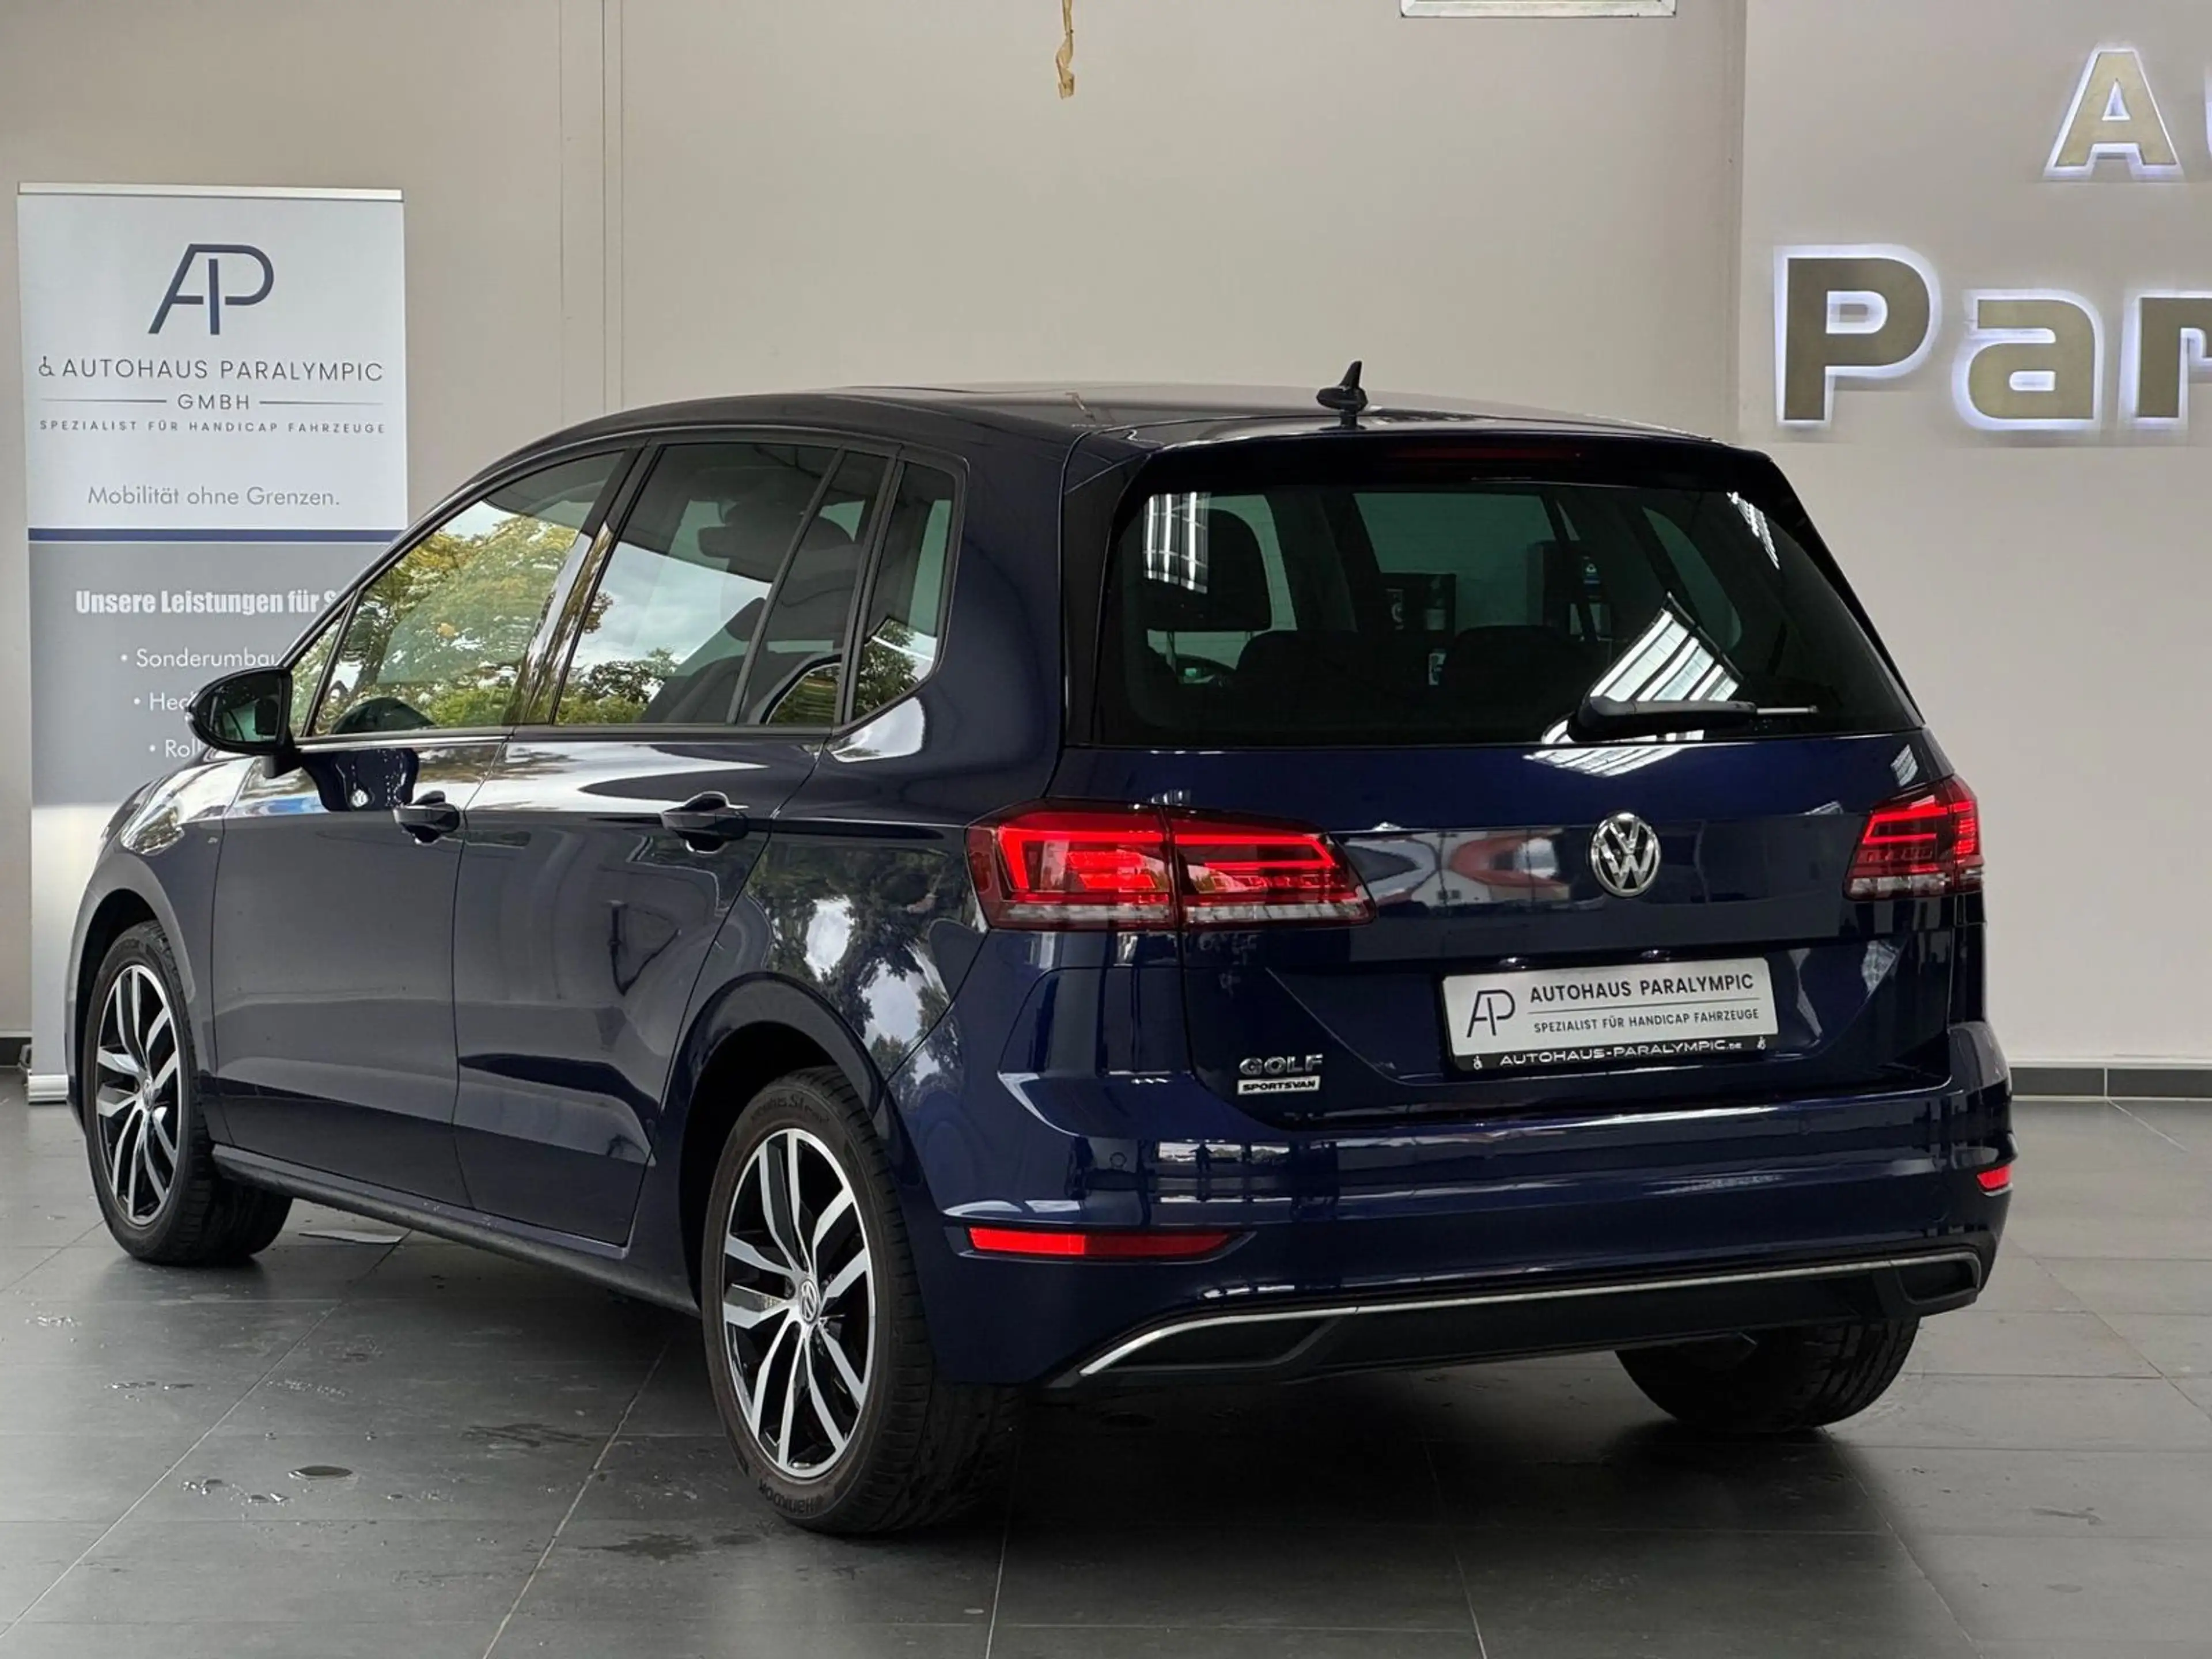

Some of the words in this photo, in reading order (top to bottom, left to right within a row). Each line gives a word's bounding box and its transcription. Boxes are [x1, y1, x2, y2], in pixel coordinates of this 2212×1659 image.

[2048, 47, 2212, 173] A
[62, 358, 208, 380] AUTOHAUS
[220, 361, 383, 382] PARALYMPIC
[177, 393, 250, 411] GMBH
[40, 419, 138, 432] SPEZIALIST
[147, 419, 179, 433] FÜR
[189, 422, 279, 434] HANDICAP
[288, 422, 385, 435] FAHRZEUGE
[88, 486, 180, 506] Mobilität
[188, 486, 239, 506] ohne
[246, 487, 340, 507] Grenzen.
[75, 589, 156, 614] Unsere
[161, 590, 283, 616] Leistungen
[287, 590, 320, 613] für
[149, 691, 195, 712] Hec
[1530, 980, 1632, 1003] AUTOHAUS
[1640, 973, 1755, 997] PARALYMPIC
[1534, 1018, 1598, 1033] SPEZIALIST
[1603, 1014, 1625, 1029] FÜR
[1629, 1012, 1690, 1027] HANDICAP
[1694, 1008, 1759, 1024] FAHRZEUGE
[1239, 1054, 1323, 1075] GOLF
[1243, 1080, 1316, 1092] SPORTSVAN
